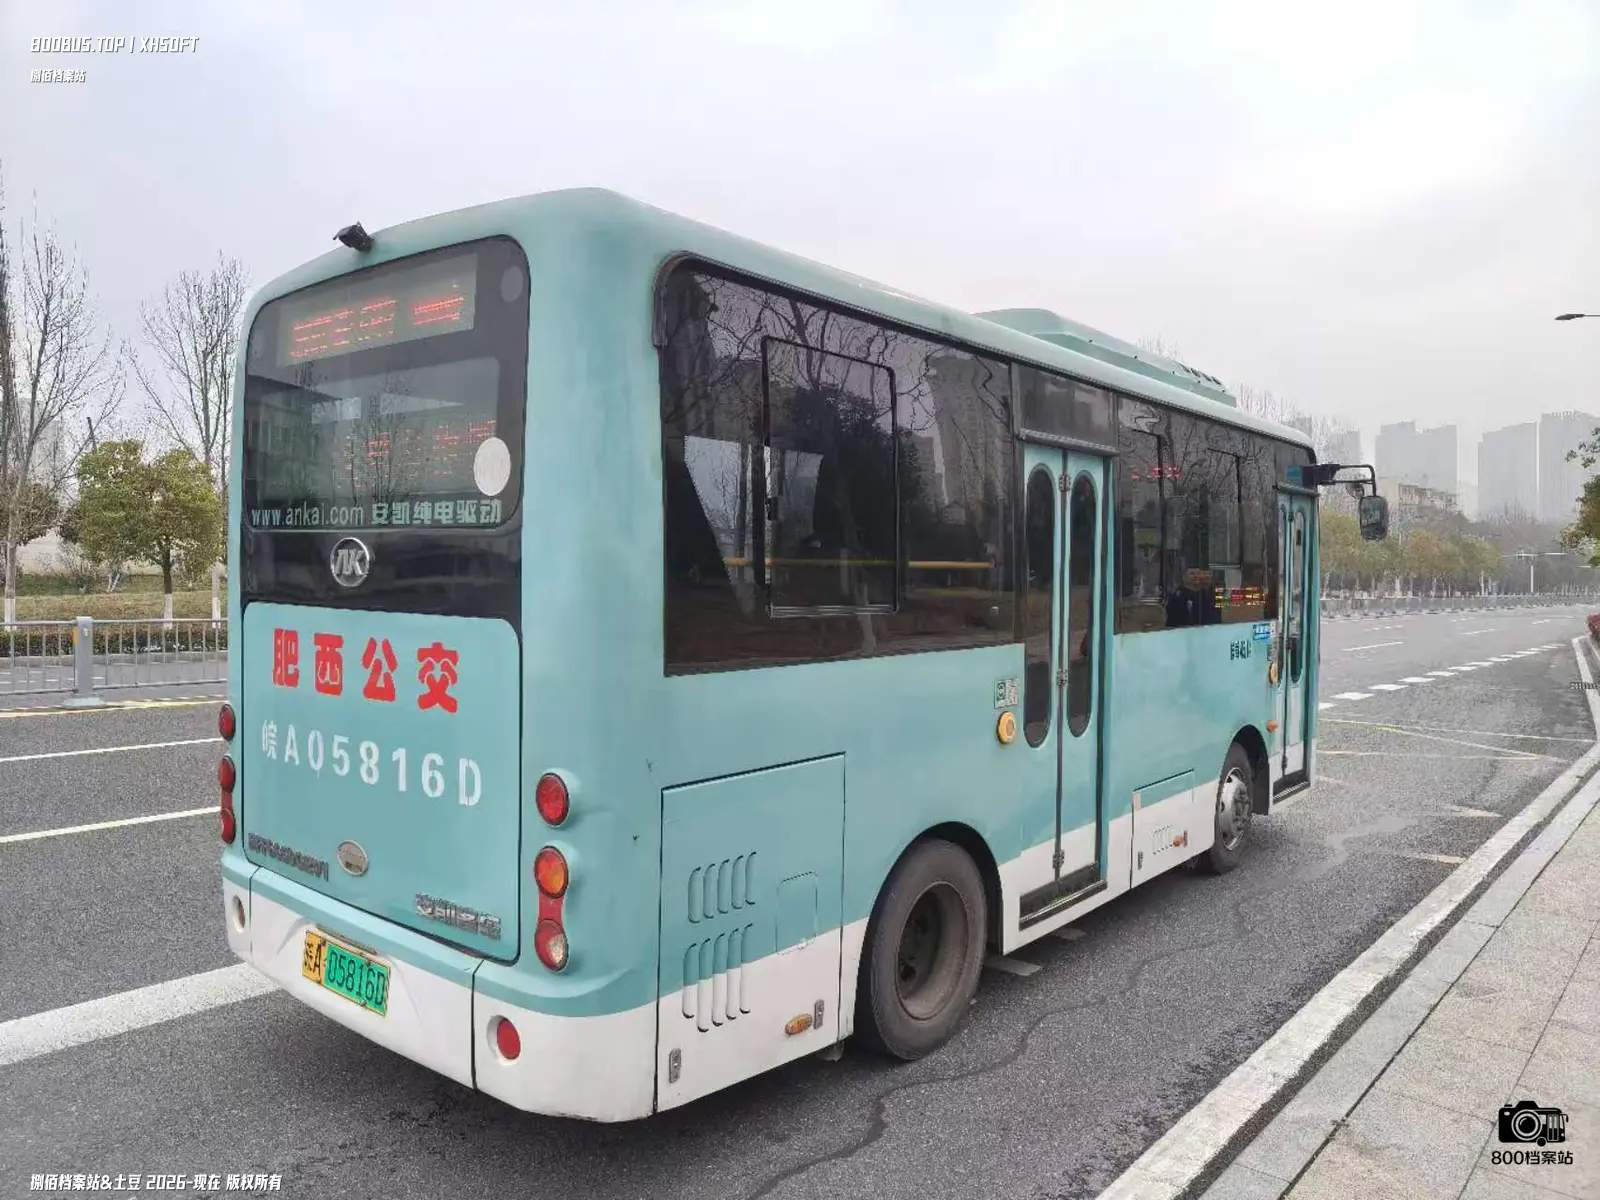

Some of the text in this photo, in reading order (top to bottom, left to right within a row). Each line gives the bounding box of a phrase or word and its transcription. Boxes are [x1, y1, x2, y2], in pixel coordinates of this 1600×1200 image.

[251, 499, 503, 527] www.ankai.com 安凯纯电驱动
[272, 627, 460, 714] 肥西公交
[261, 719, 483, 808] 皖A05816D
